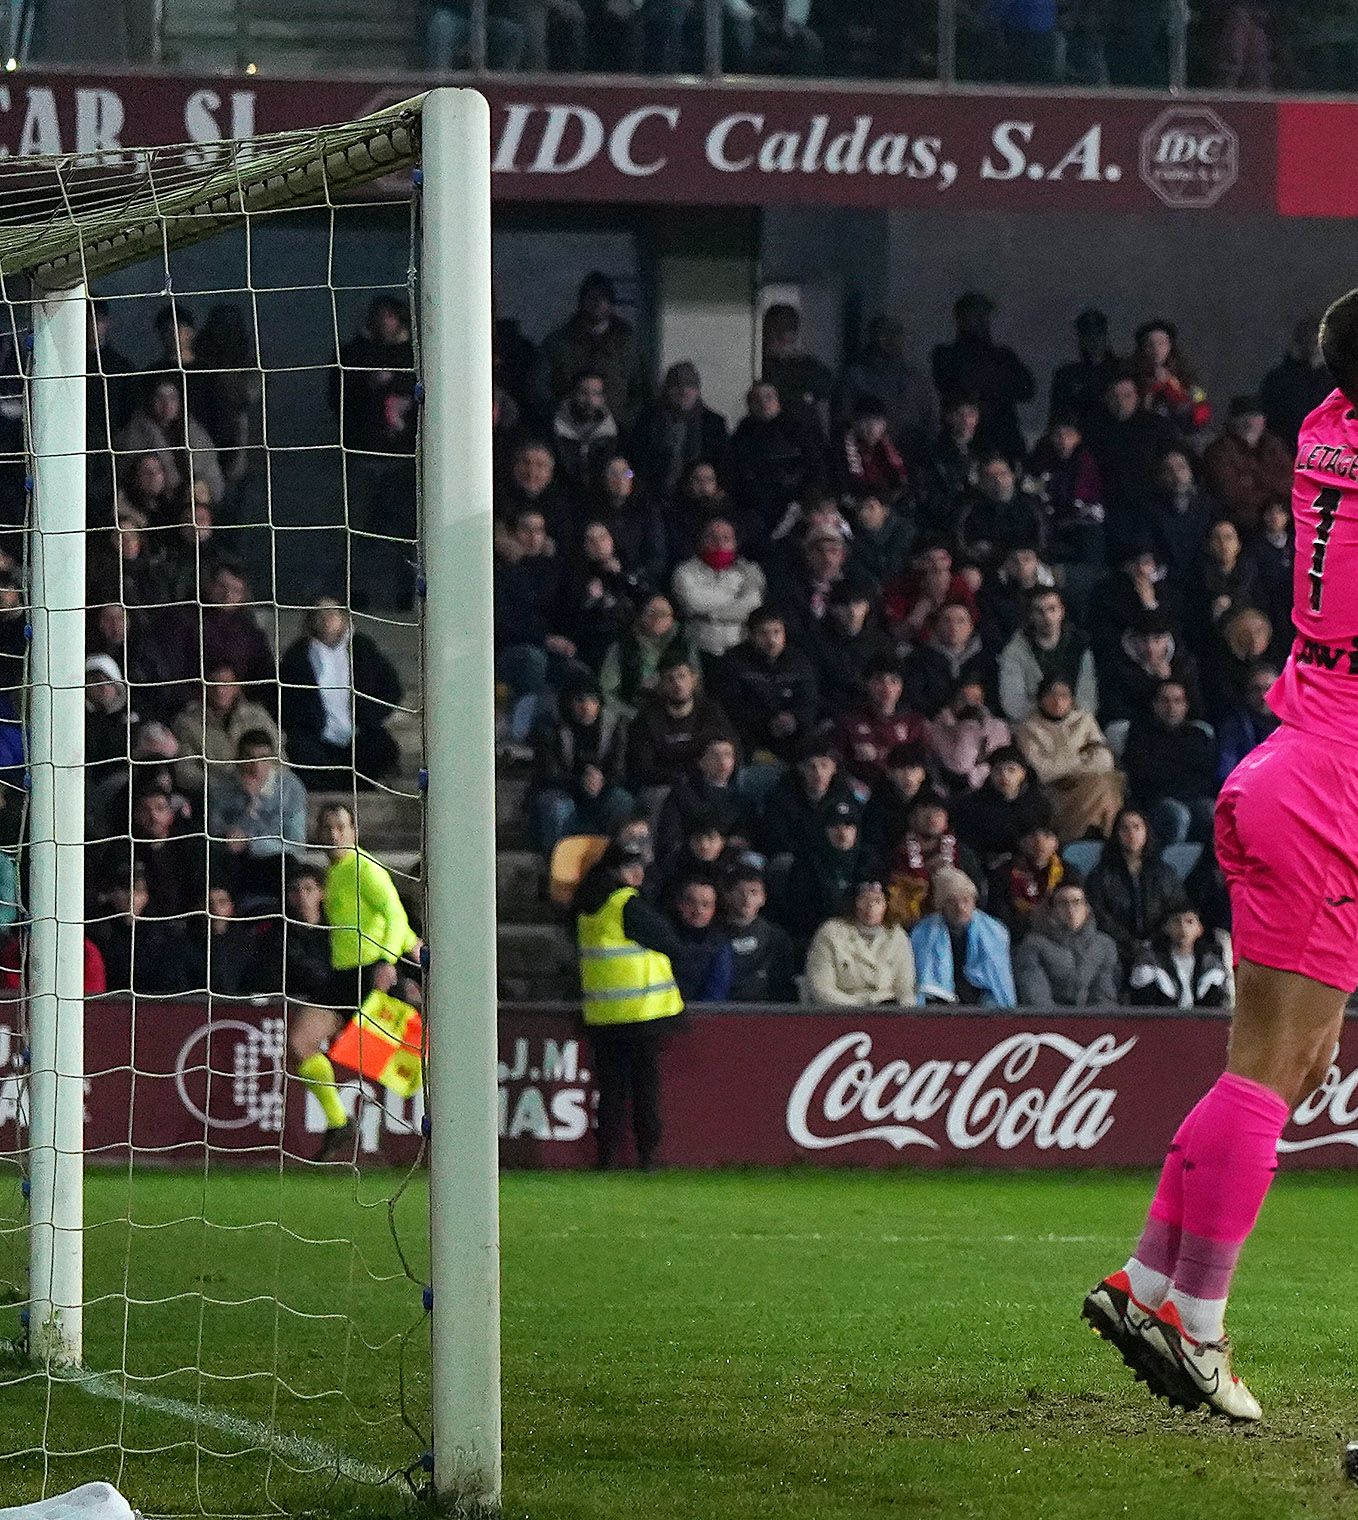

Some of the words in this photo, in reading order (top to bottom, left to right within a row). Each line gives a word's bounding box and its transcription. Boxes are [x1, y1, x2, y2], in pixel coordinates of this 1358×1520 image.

[0, 87, 152, 178] AR,
[490, 103, 681, 176] IDC
[705, 110, 958, 191] Caldas,
[980, 119, 1122, 183] S.A.
[1308, 486, 1343, 615] 1
[787, 1031, 1139, 1150] Coca-Cola
